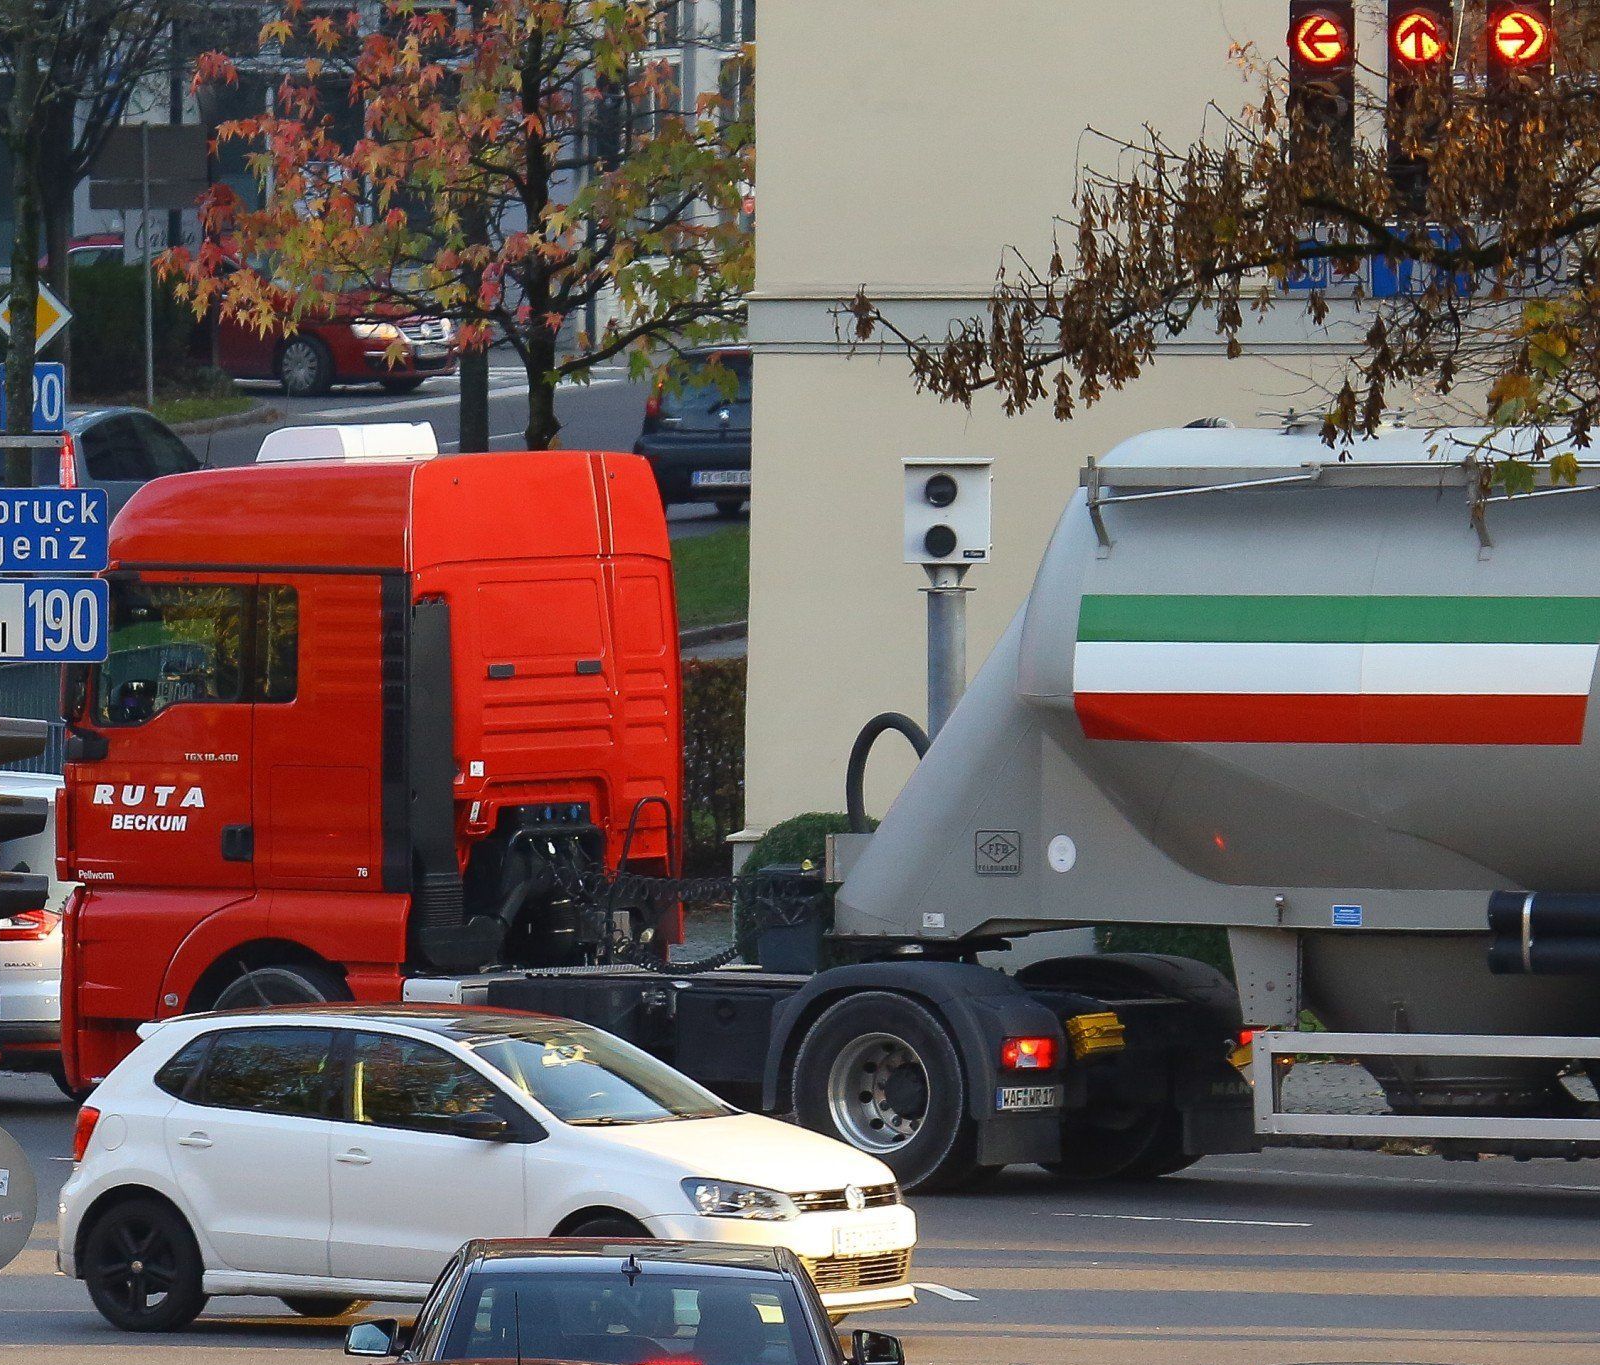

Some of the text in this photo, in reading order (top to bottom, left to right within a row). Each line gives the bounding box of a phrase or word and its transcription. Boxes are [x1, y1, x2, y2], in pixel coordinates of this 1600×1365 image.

[29, 588, 97, 653] 190
[93, 784, 205, 808] RUTA
[111, 814, 187, 831] BECKUM
[78, 869, 115, 880] Pellworm
[356, 867, 368, 878] 76
